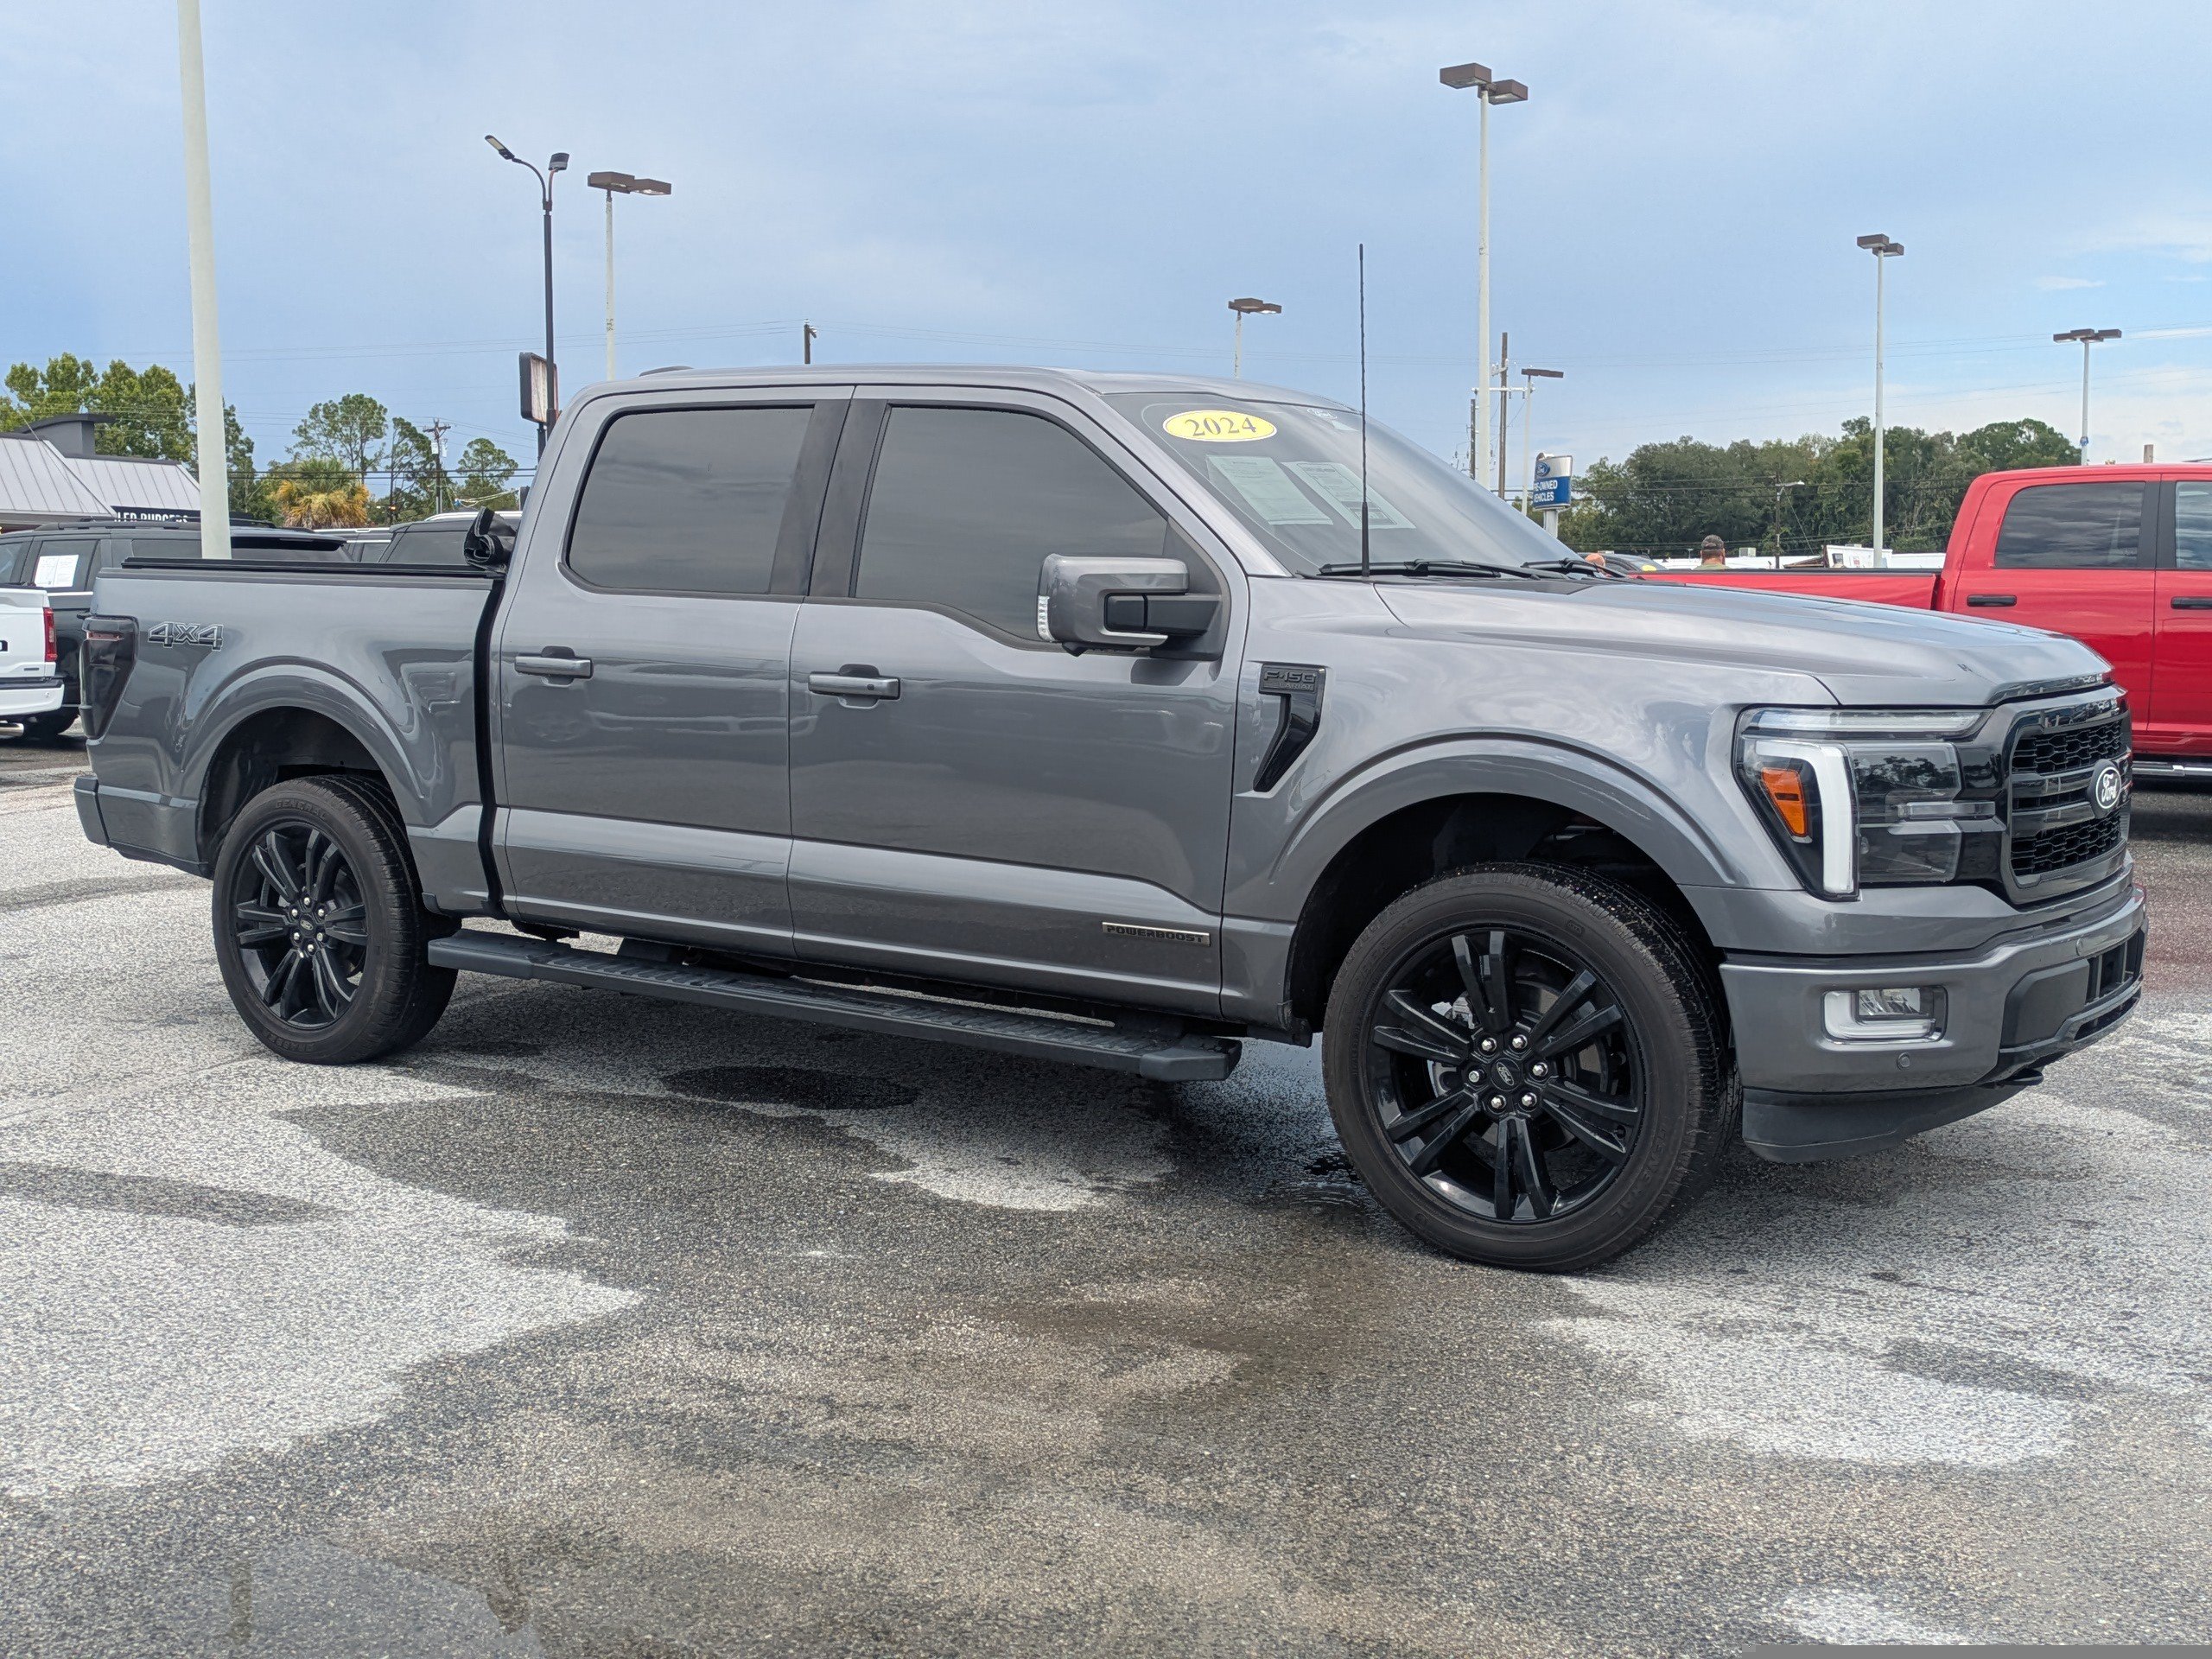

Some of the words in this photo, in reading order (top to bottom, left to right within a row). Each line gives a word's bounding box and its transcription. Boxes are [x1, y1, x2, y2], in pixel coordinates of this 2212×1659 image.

[1185, 417, 1256, 436] 2024
[1263, 671, 1317, 684] F-150
[2100, 771, 2120, 805] Ford
[1107, 925, 1203, 943] POWERBOOST
